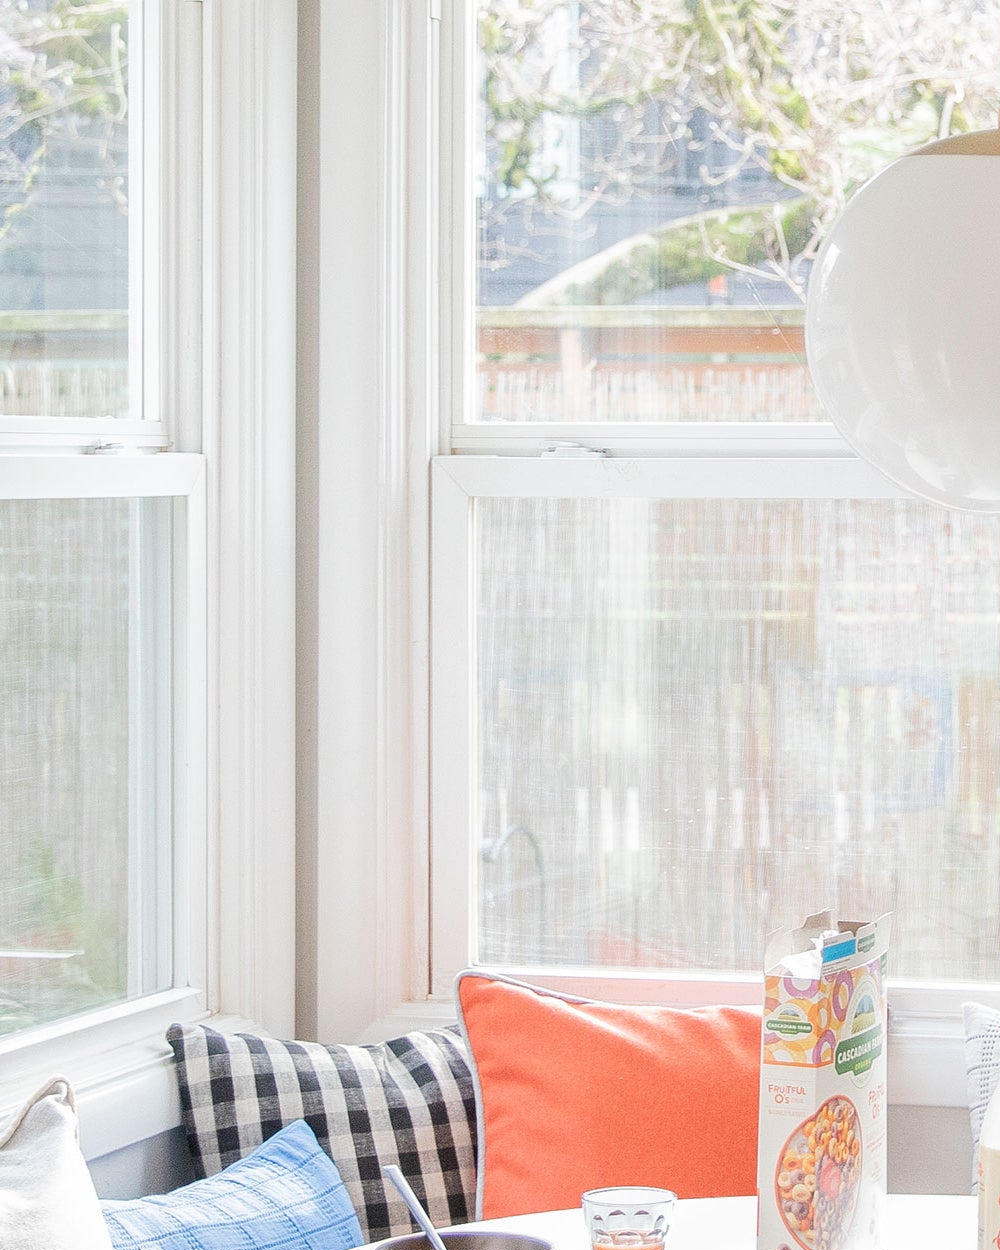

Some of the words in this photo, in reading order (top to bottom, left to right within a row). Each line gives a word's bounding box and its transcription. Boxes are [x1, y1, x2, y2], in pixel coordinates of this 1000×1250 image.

[767, 1022, 798, 1030] CASCADIAN
[837, 1041, 872, 1064] CASCADIAN
[768, 1084, 806, 1096] FRUITFUL
